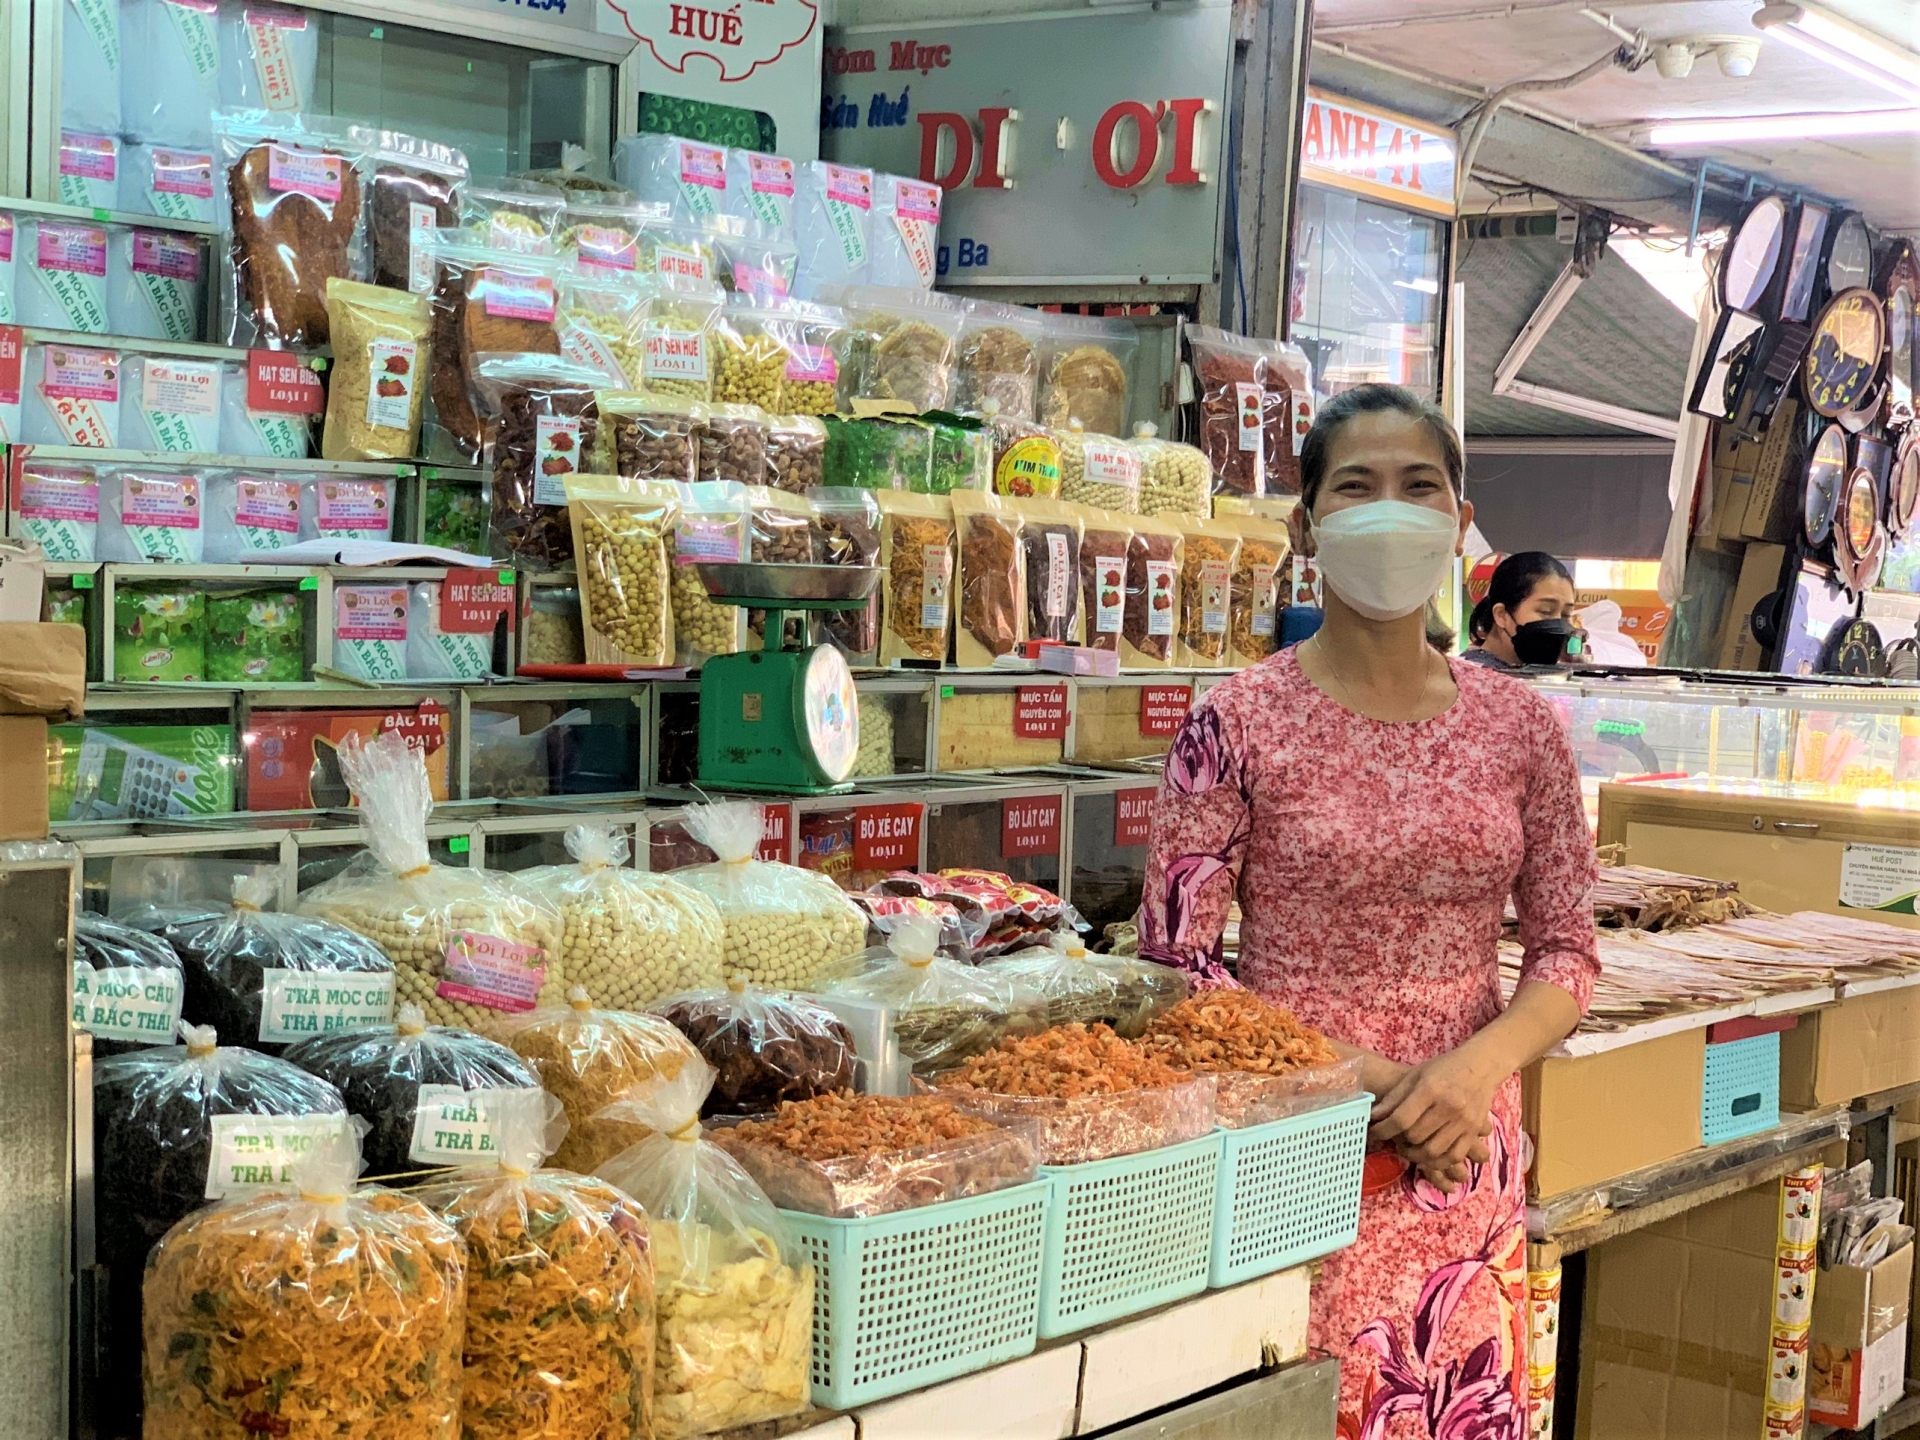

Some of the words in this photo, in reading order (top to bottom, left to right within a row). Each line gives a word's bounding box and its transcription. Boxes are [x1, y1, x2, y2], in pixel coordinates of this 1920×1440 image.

[669, 4, 744, 46] HUẾ
[888, 40, 951, 76] Mực
[958, 239, 989, 267] Ba
[683, 336, 699, 357] HUẾ
[258, 365, 277, 386] HẠT
[279, 367, 298, 383] SEN
[270, 389, 299, 403] LOẠI
[451, 585, 469, 607] HẠT
[463, 610, 491, 623] LOẠI
[1020, 689, 1041, 706] MỰC
[1043, 687, 1062, 703] TẨM
[1148, 689, 1167, 706] MỰC
[1169, 687, 1187, 703] TẨM
[1020, 707, 1046, 719] NGUYÊN
[1048, 709, 1062, 719] CON
[1147, 706, 1171, 718] NGUYÊN
[1172, 708, 1184, 718] CON
[1025, 722, 1047, 733] LOẠI
[1152, 720, 1171, 733] LOẠI
[1008, 804, 1021, 829] BÒ
[1022, 804, 1039, 828] LÁT
[1039, 807, 1055, 827] CAY
[1120, 797, 1132, 819] BÒ
[1133, 795, 1149, 818] LÁT
[764, 810, 783, 840] ẨM
[861, 814, 875, 839] BÒ
[877, 813, 891, 838] XÉ
[893, 816, 914, 837] CAY
[1127, 825, 1148, 838] LOẠI
[870, 846, 895, 859] LOẠI
[1017, 836, 1041, 849] LOẠI
[145, 982, 174, 1003] CÂU
[285, 985, 320, 1004] TRÀ
[366, 987, 390, 1006] CÂU
[92, 1001, 133, 1027] BẮC
[138, 1009, 171, 1031] THÁI
[282, 1010, 318, 1031] TRÀ
[442, 1101, 477, 1122] TRÀ
[234, 1131, 274, 1152] TRÀ
[435, 1127, 474, 1150] TRÀ
[231, 1160, 274, 1183] TRÀ
